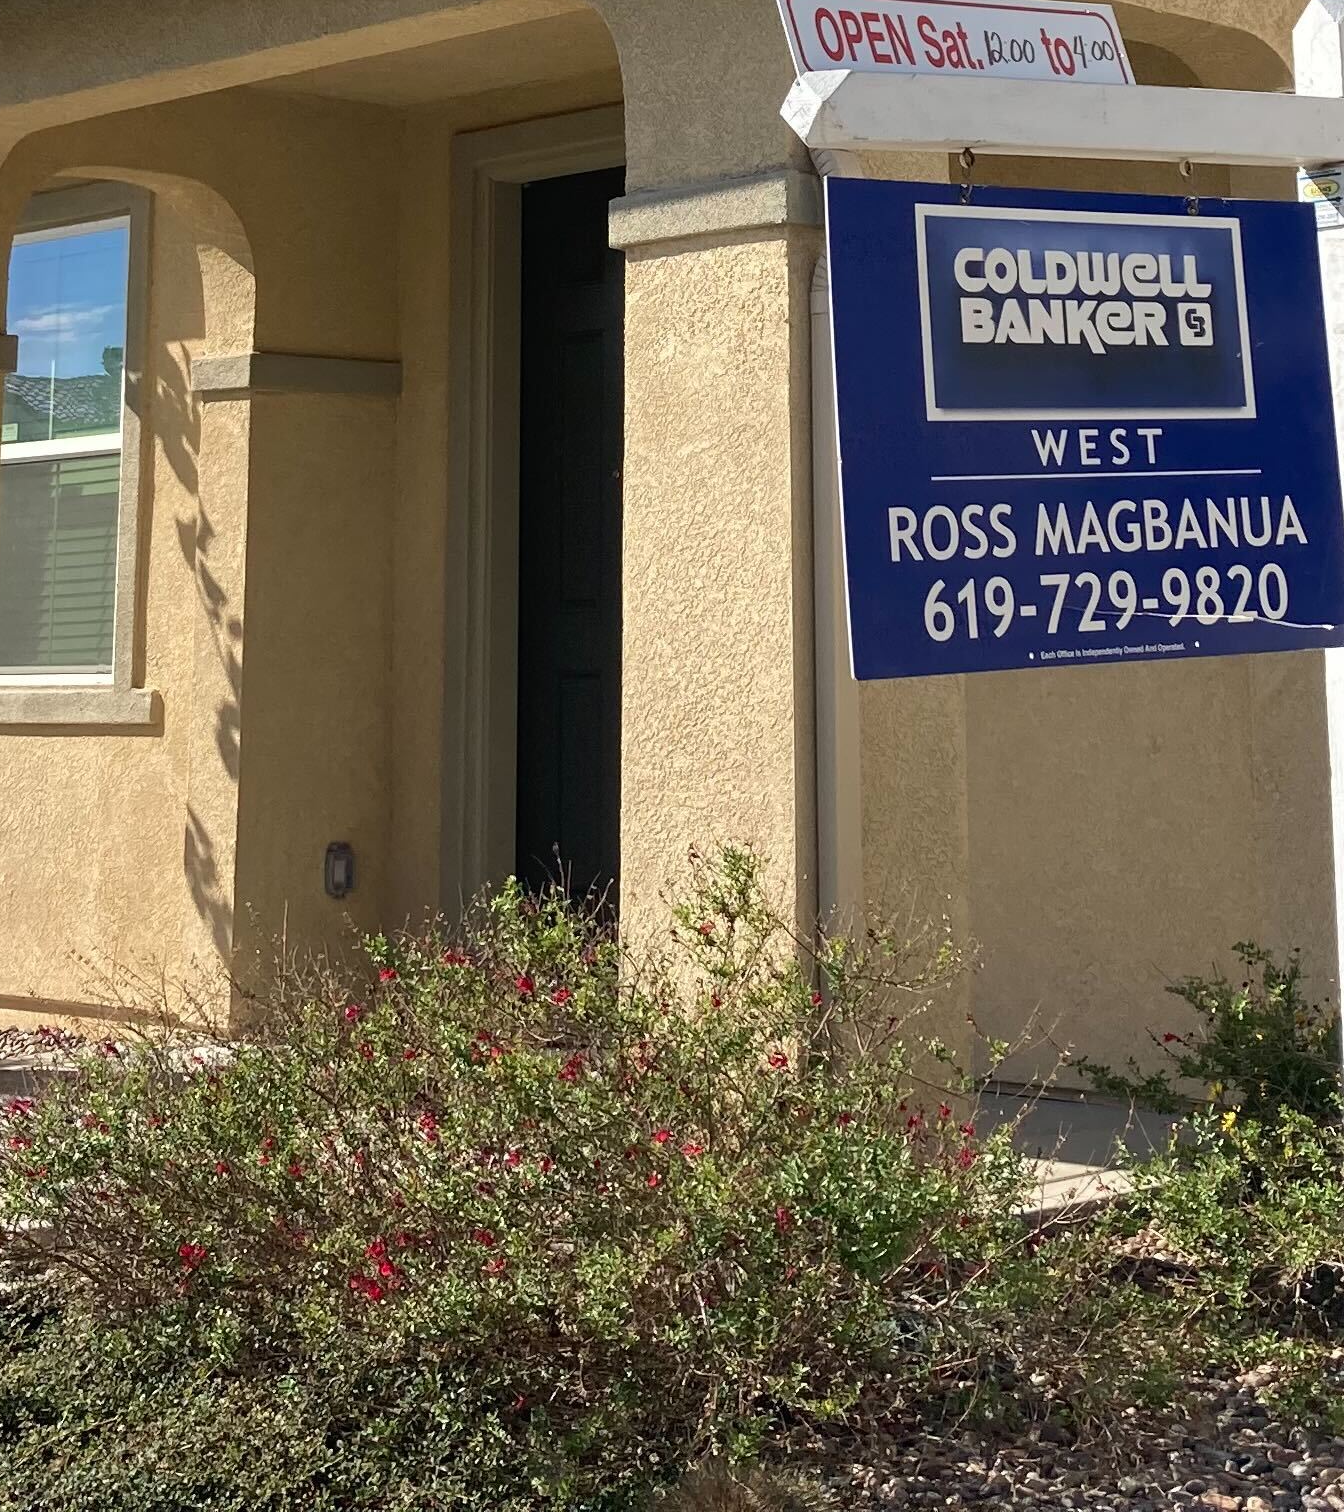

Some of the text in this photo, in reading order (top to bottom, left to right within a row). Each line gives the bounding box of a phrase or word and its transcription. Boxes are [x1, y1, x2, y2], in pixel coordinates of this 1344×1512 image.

[814, 7, 917, 66] OPEN
[917, 15, 985, 70] Sat.
[1039, 28, 1076, 76] to
[954, 247, 1212, 298] COLDWELL
[960, 297, 1170, 354] BANKER
[1031, 427, 1163, 467] WEST
[887, 494, 1308, 563] ROSS MAGBANUA
[924, 562, 1289, 642] 619-729-9820
